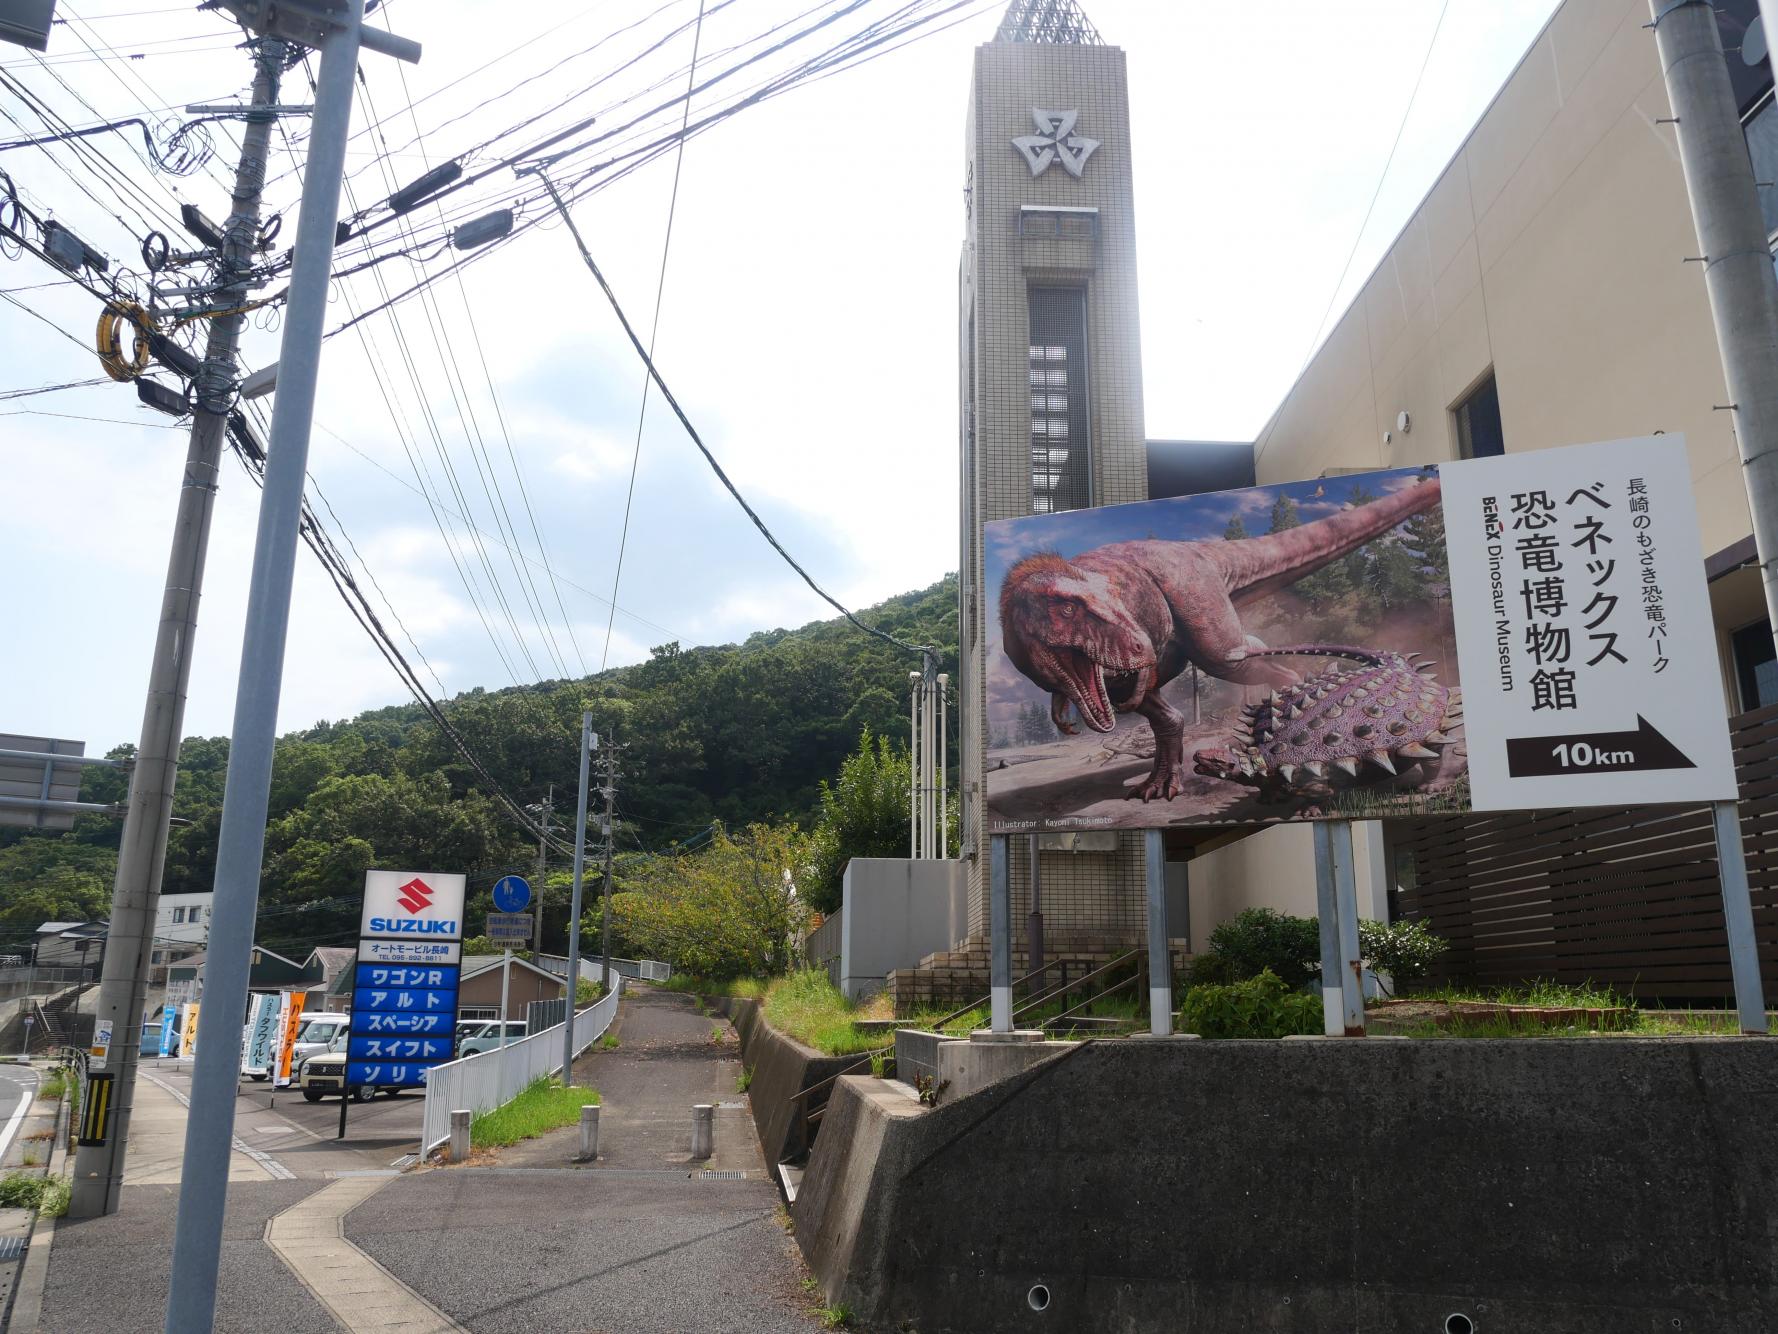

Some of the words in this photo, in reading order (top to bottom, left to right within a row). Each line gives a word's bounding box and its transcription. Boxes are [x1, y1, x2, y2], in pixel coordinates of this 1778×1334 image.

[1488, 545, 1506, 617] Dinosaur
[1565, 481, 1629, 667] ベネックス
[1627, 478, 1670, 674] 長崎のもざき恐竜パーク
[1510, 490, 1578, 711] 恐竜博物館
[1495, 620, 1514, 692] Museum
[1552, 743, 1635, 768] 10km
[370, 918, 456, 934] SUZUKI
[371, 944, 449, 955] オートモービル長崎
[372, 969, 443, 985] ワゴンR
[371, 992, 440, 1008] アルト
[186, 1012, 197, 1048] アルト
[368, 1015, 439, 1031] スペーシア
[366, 1040, 437, 1057] スイフト
